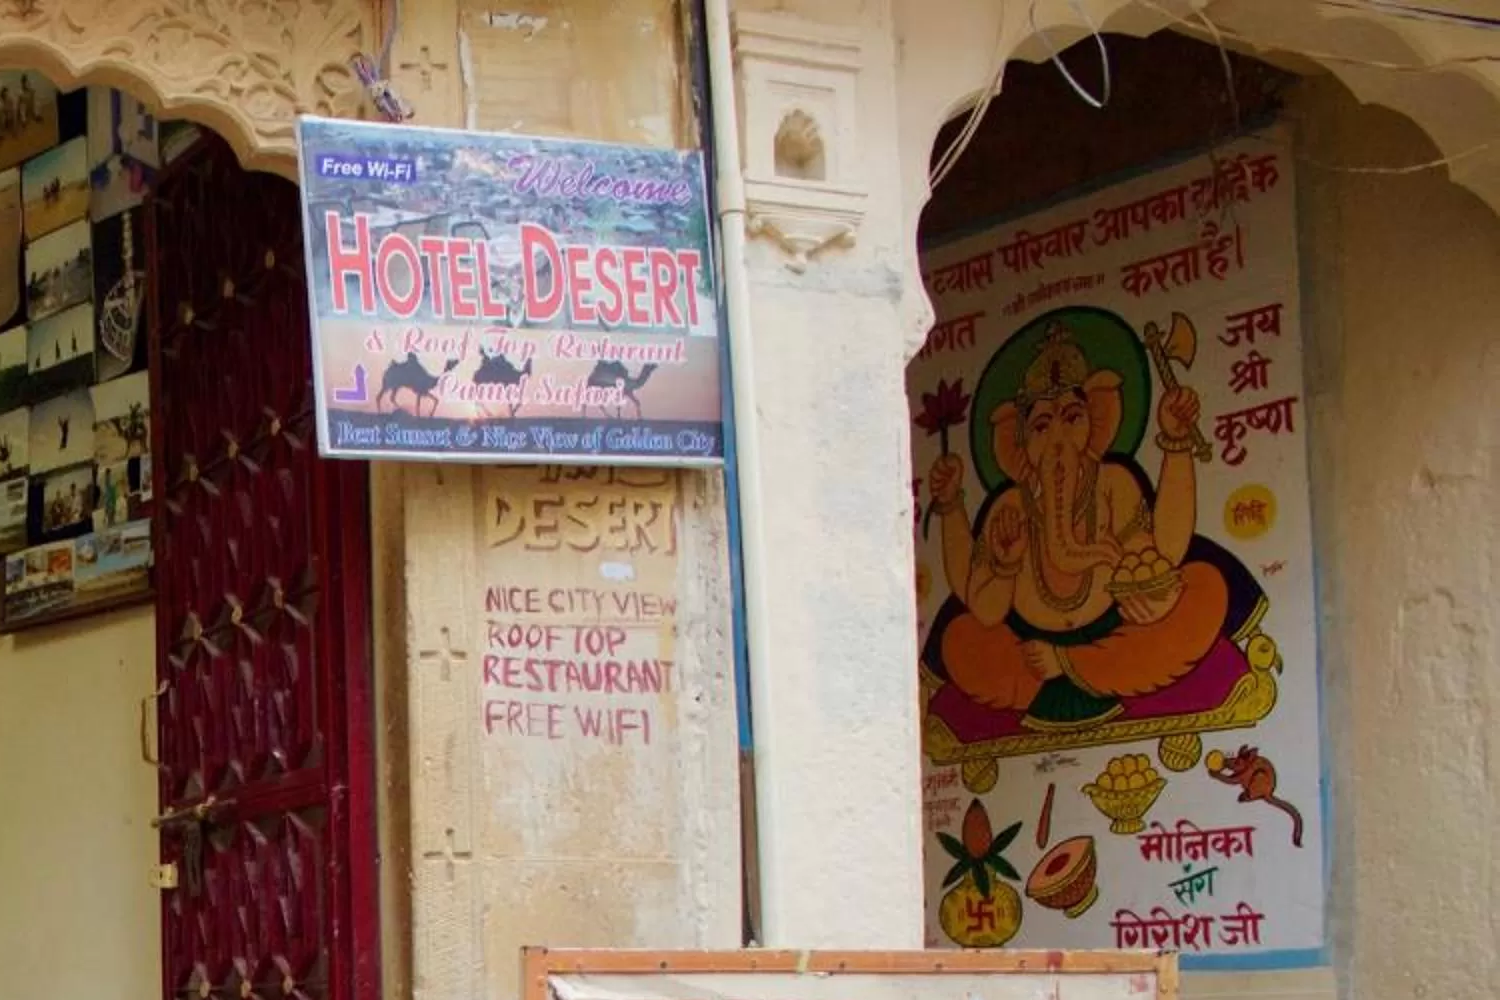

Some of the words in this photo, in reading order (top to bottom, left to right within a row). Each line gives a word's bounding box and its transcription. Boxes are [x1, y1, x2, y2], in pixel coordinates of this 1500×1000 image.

[321, 158, 363, 176] Free
[367, 160, 411, 180] Wi-Fi
[509, 154, 691, 203] Welcome
[998, 223, 1088, 275] परिवार
[1091, 187, 1185, 245] आपका
[326, 211, 506, 319] HOTEL
[520, 224, 701, 327] DESERT
[1120, 246, 1200, 298] करता
[1218, 303, 1282, 348] जय
[436, 373, 528, 402] Camel
[534, 375, 627, 405] Safari
[1229, 350, 1271, 394] श्री
[485, 587, 541, 613] NICE
[548, 591, 604, 614] CITY
[612, 591, 677, 618] VIEW
[487, 623, 562, 649] ROOF
[572, 626, 627, 656] TOP
[483, 656, 675, 694] RESTAURANT
[484, 701, 565, 739] FREE
[575, 705, 649, 745] WIFI
[1139, 820, 1257, 863] मोनिका
[1169, 863, 1218, 905] संग
[1219, 902, 1265, 947] जी
